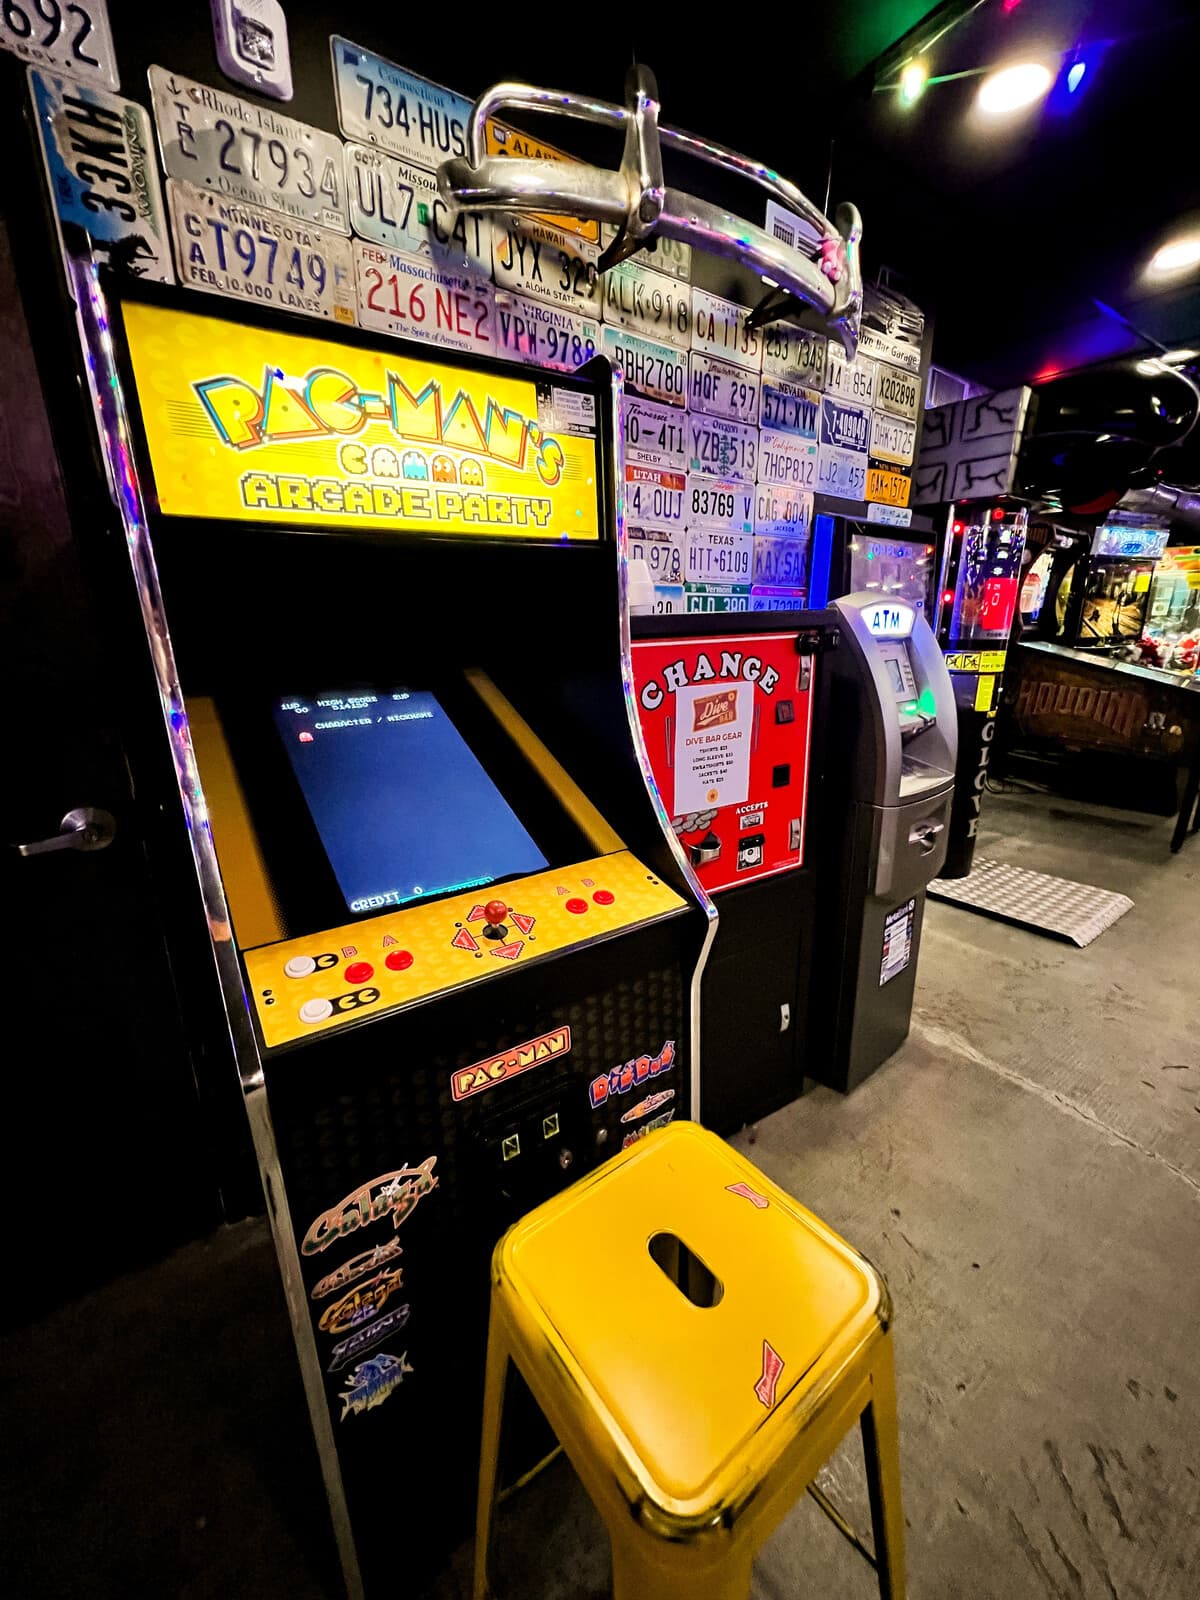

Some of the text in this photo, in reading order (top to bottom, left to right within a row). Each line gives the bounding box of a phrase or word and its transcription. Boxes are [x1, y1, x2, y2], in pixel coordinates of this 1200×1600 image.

[201, 89, 305, 140] Rhode Island
[214, 119, 340, 209] 27934
[217, 175, 267, 204] Ocean
[354, 165, 415, 231] UL7
[219, 205, 311, 248] MINNESOTA
[362, 248, 468, 291] FEB Massachusetts
[190, 265, 217, 286] FEB
[279, 290, 322, 313] LAKES
[525, 281, 551, 298] ALOHA
[365, 267, 490, 341] 216 NE2
[521, 302, 574, 331] VIRGINIA
[395, 320, 410, 334] The
[411, 323, 431, 342] Spirit
[431, 329, 441, 341] of
[697, 309, 714, 343] CA
[730, 381, 755, 412] 297
[636, 451, 662, 463] SHELBY
[763, 451, 814, 486] 7HGP812
[633, 468, 662, 484] UTAH
[241, 471, 552, 528] ARCADE PARTY
[692, 489, 751, 520] 83769 V
[708, 534, 734, 546] TEXAS
[706, 584, 733, 594] Vermont
[873, 610, 900, 629] ATM
[640, 652, 780, 711] CHANGE
[314, 717, 372, 730] CHARACTER
[699, 699, 729, 721] Dive
[685, 731, 742, 746] DIVE BAR GEAR
[735, 801, 769, 814] ACCEPTS
[350, 885, 423, 913] CREDIT 0
[556, 885, 571, 896] A
[341, 934, 399, 959] B A
[457, 1033, 565, 1093] PAC-MAN
